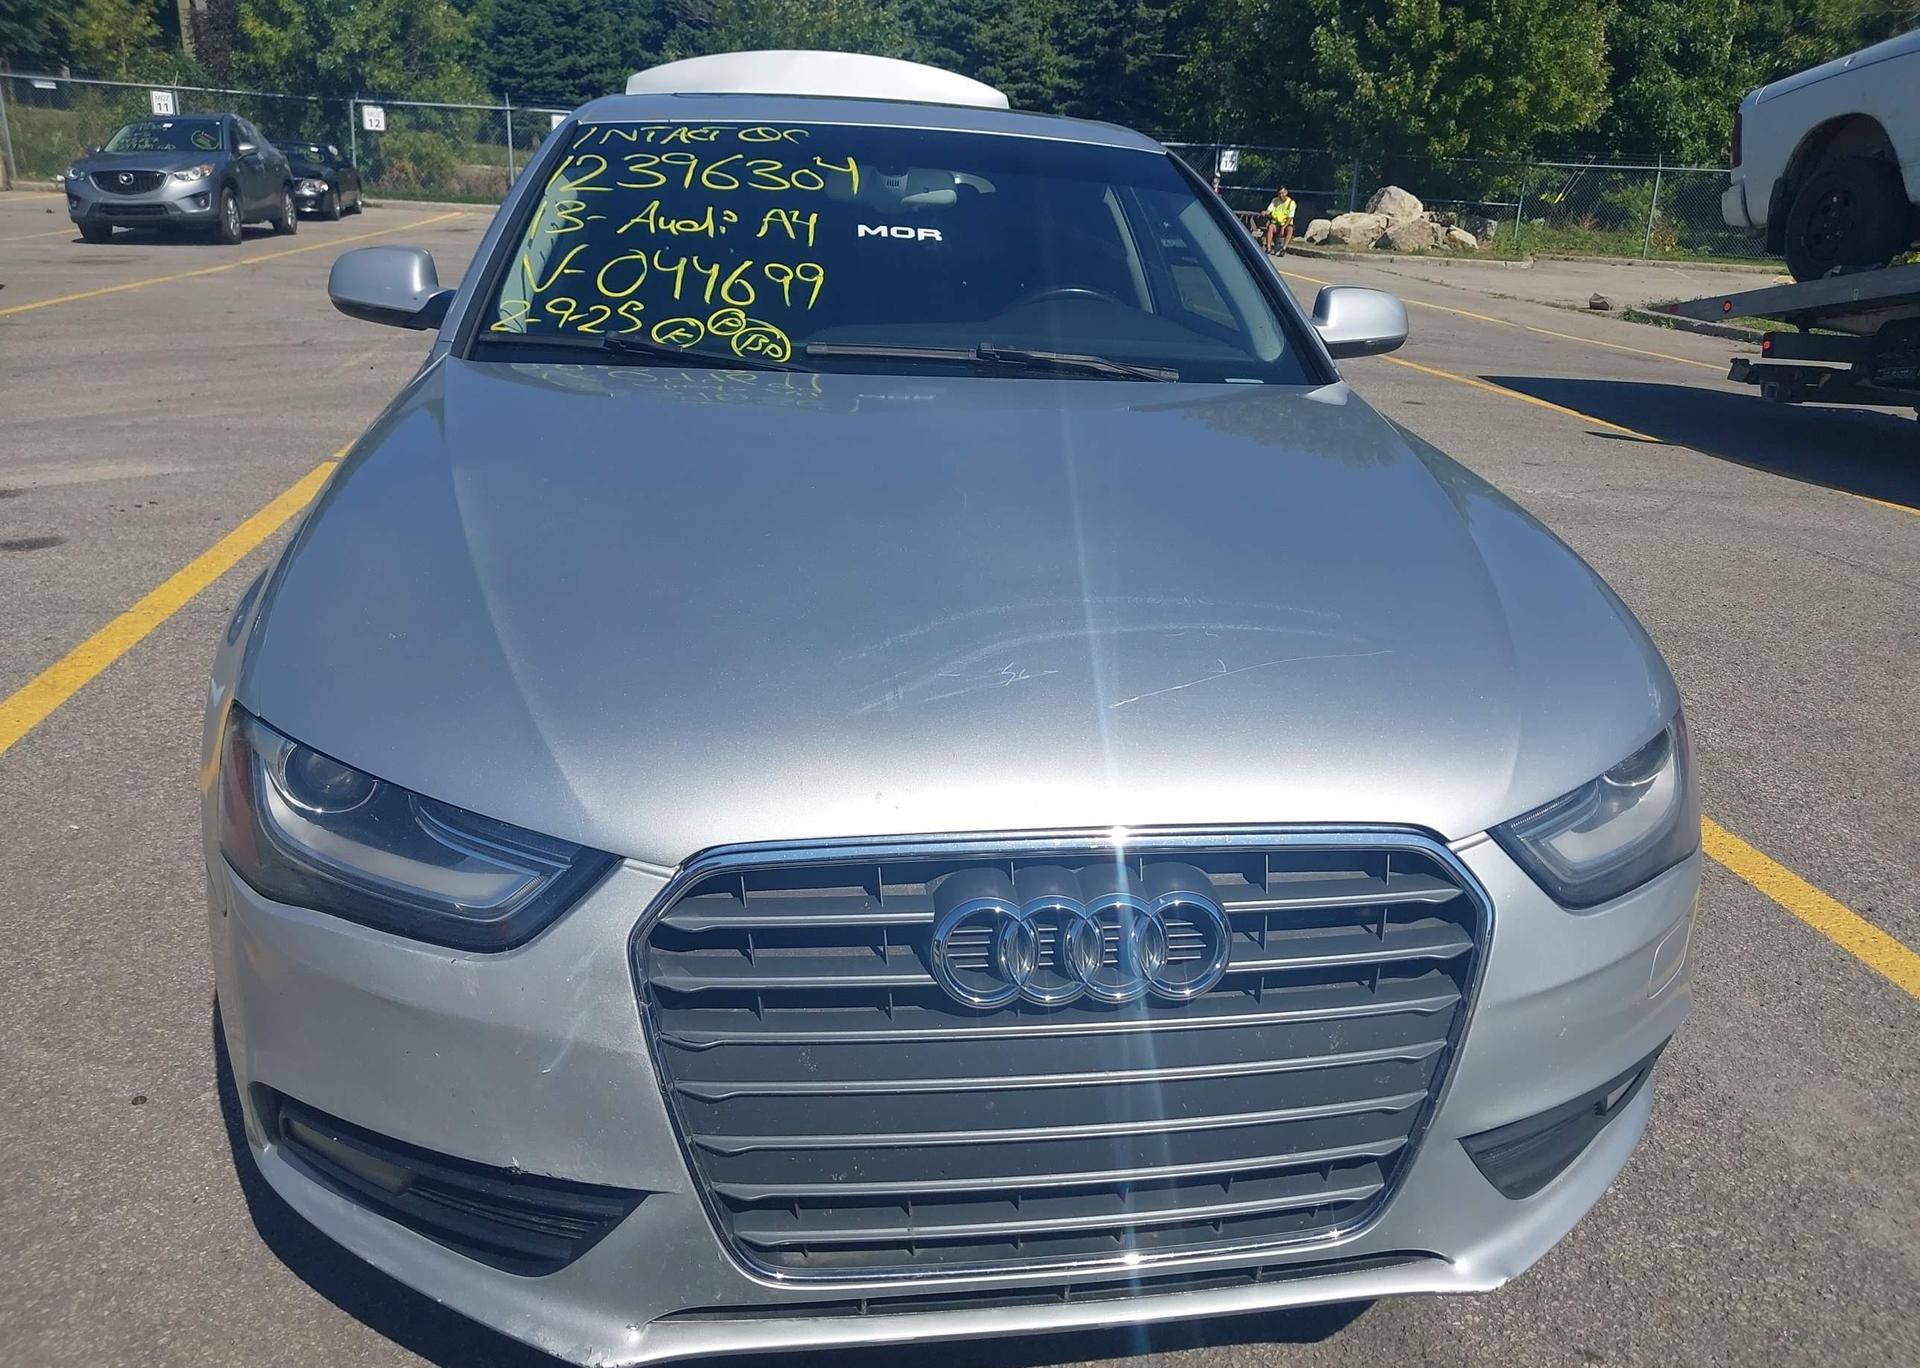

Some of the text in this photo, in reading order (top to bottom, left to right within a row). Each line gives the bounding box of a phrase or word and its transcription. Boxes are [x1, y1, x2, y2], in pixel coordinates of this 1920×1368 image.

[157, 102, 169, 112] 11
[369, 118, 382, 129] 12
[544, 152, 860, 196] 12396304
[756, 208, 818, 247] A4
[856, 223, 944, 242] MOR
